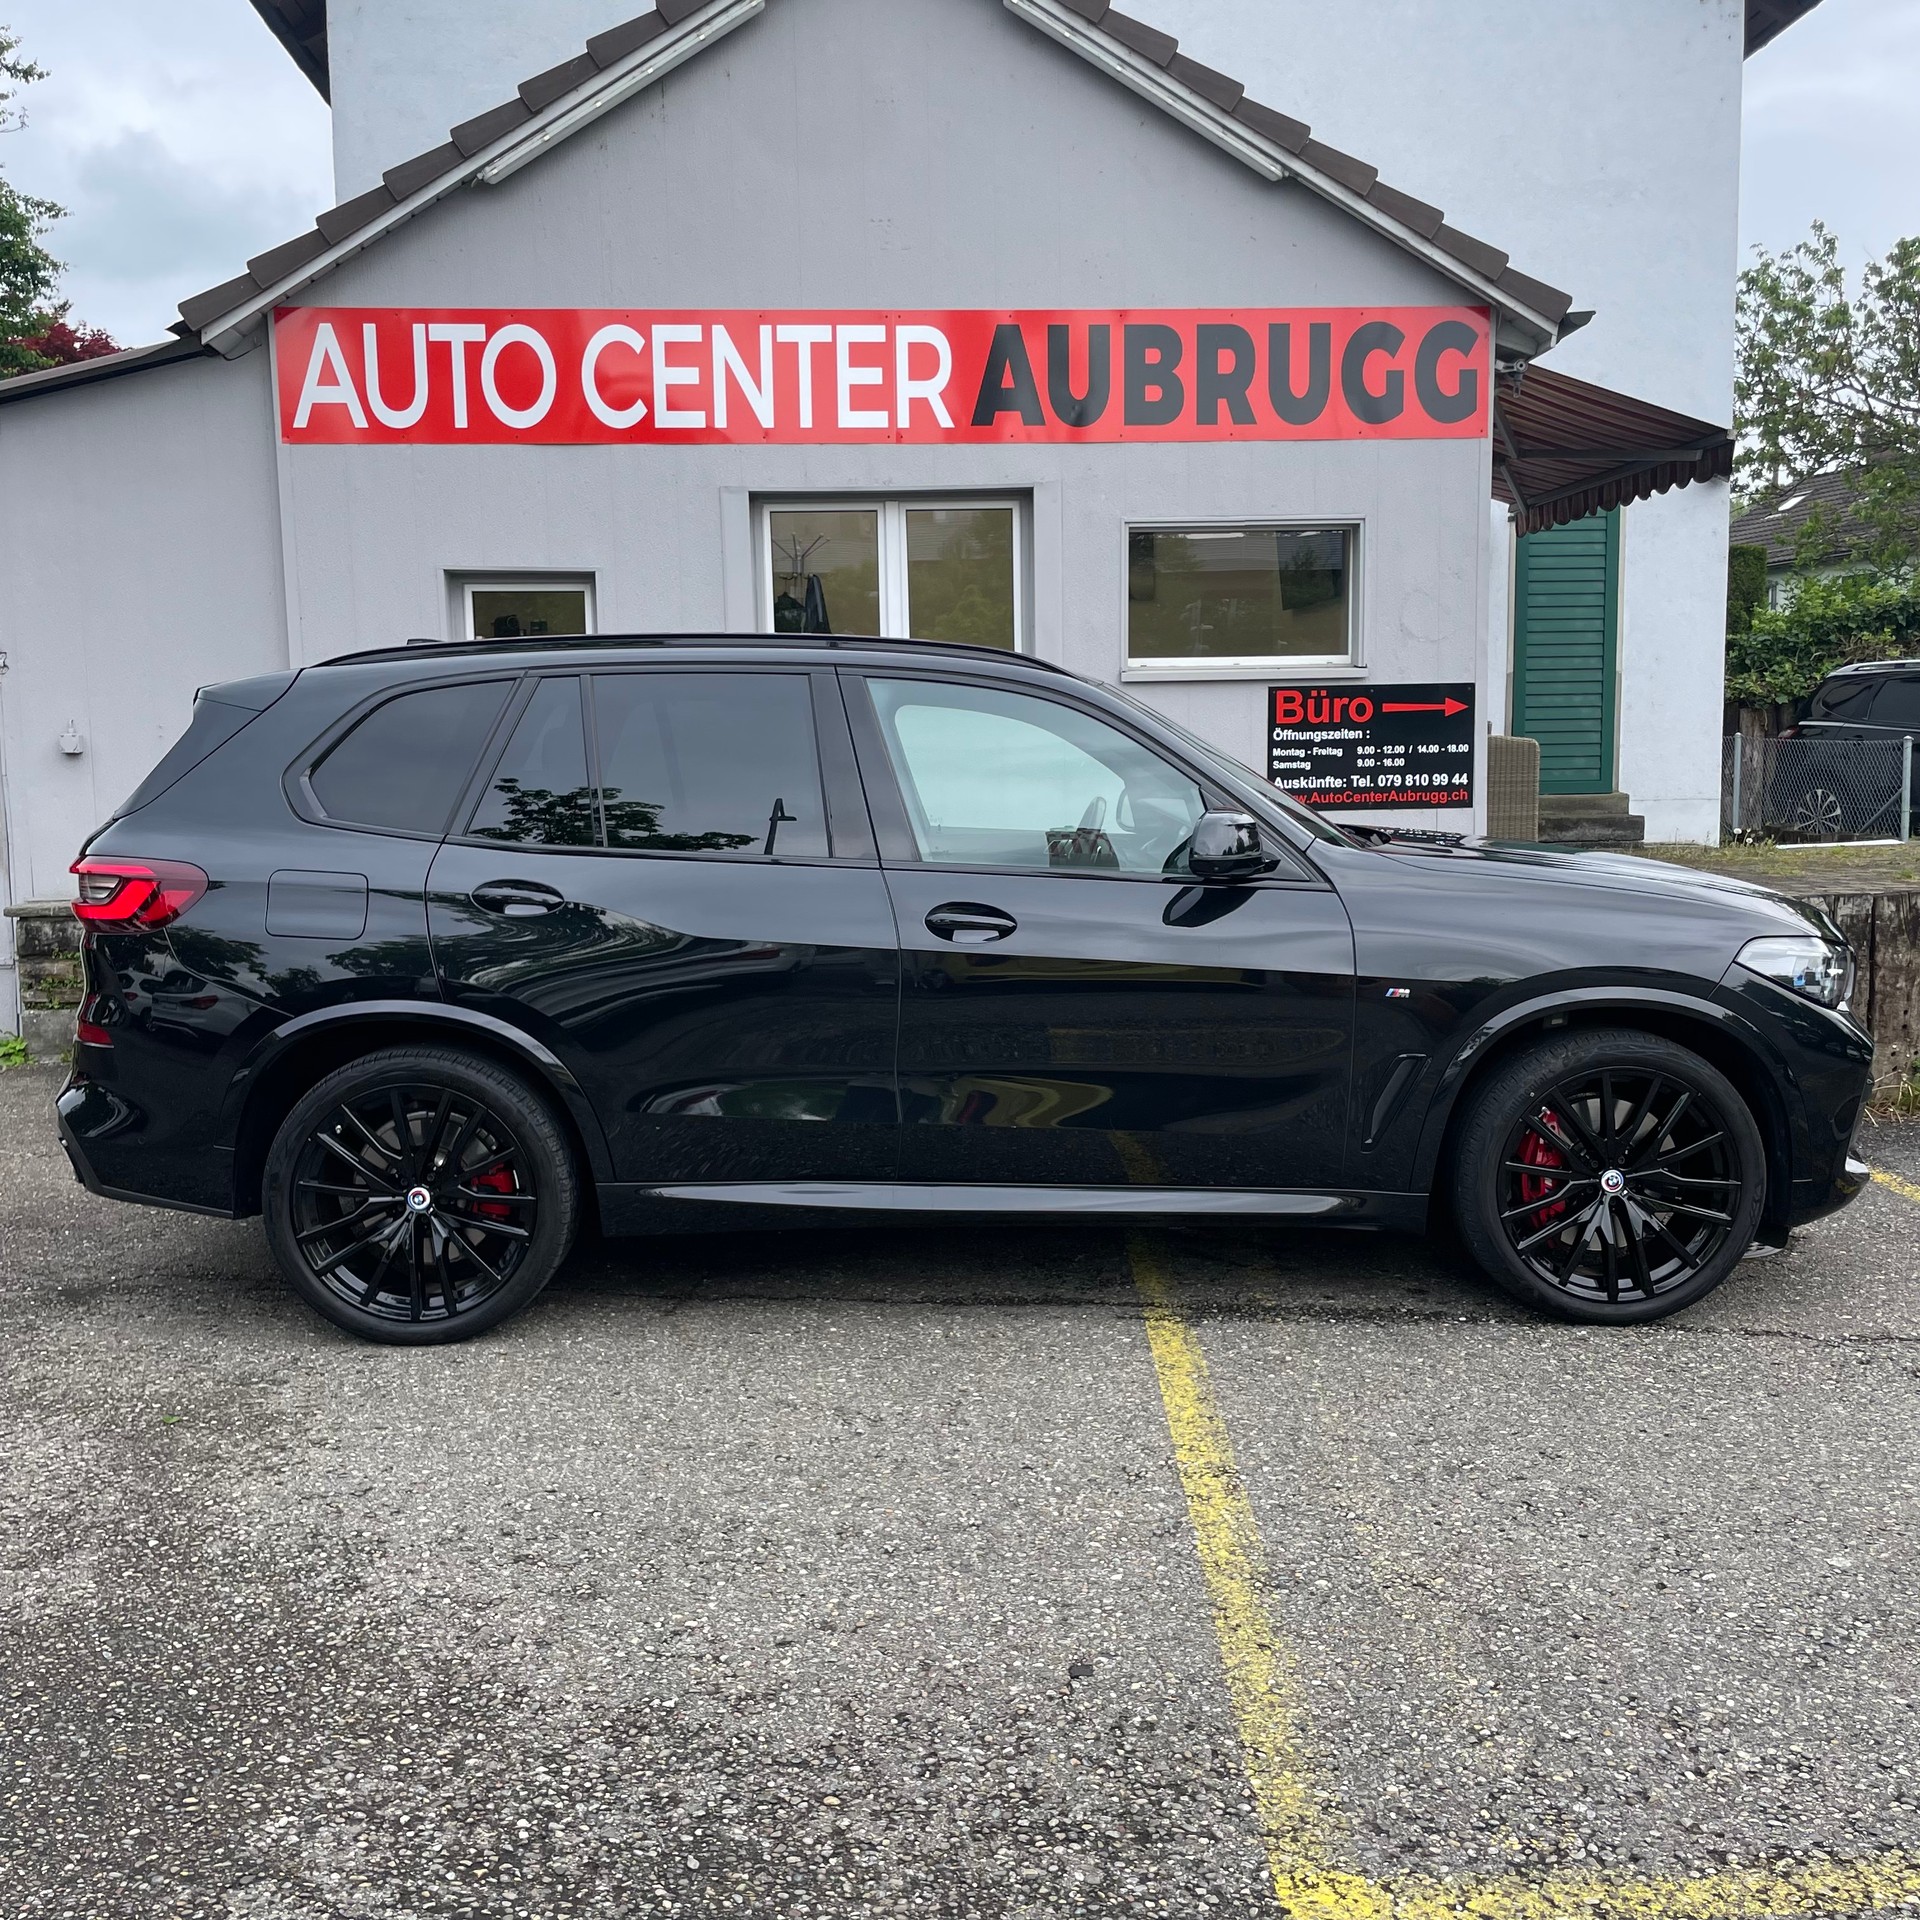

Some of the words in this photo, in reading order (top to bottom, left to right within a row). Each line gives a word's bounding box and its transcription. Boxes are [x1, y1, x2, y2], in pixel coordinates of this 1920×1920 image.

[292, 322, 557, 430] AUTO
[580, 323, 956, 430] CENTER
[970, 320, 1480, 427] AUBRUGG
[1275, 689, 1374, 724] Büro
[1272, 728, 1363, 742] Öffnungszeiten
[1272, 747, 1306, 758] Montag
[1312, 746, 1344, 757] Freitag
[1356, 746, 1376, 755] 9.00
[1382, 745, 1406, 755] 12.00
[1417, 744, 1440, 754] 14.00
[1446, 743, 1470, 753] 18.00
[1272, 759, 1312, 771] Samstag
[1356, 758, 1376, 768] 9.00
[1382, 757, 1406, 768] 16.00
[1273, 775, 1348, 790] Auskünfte:
[1350, 774, 1375, 788] Tel.
[1377, 774, 1402, 787] 079
[1405, 773, 1429, 786] 810
[1431, 773, 1449, 786] 99
[1450, 772, 1469, 786] 44
